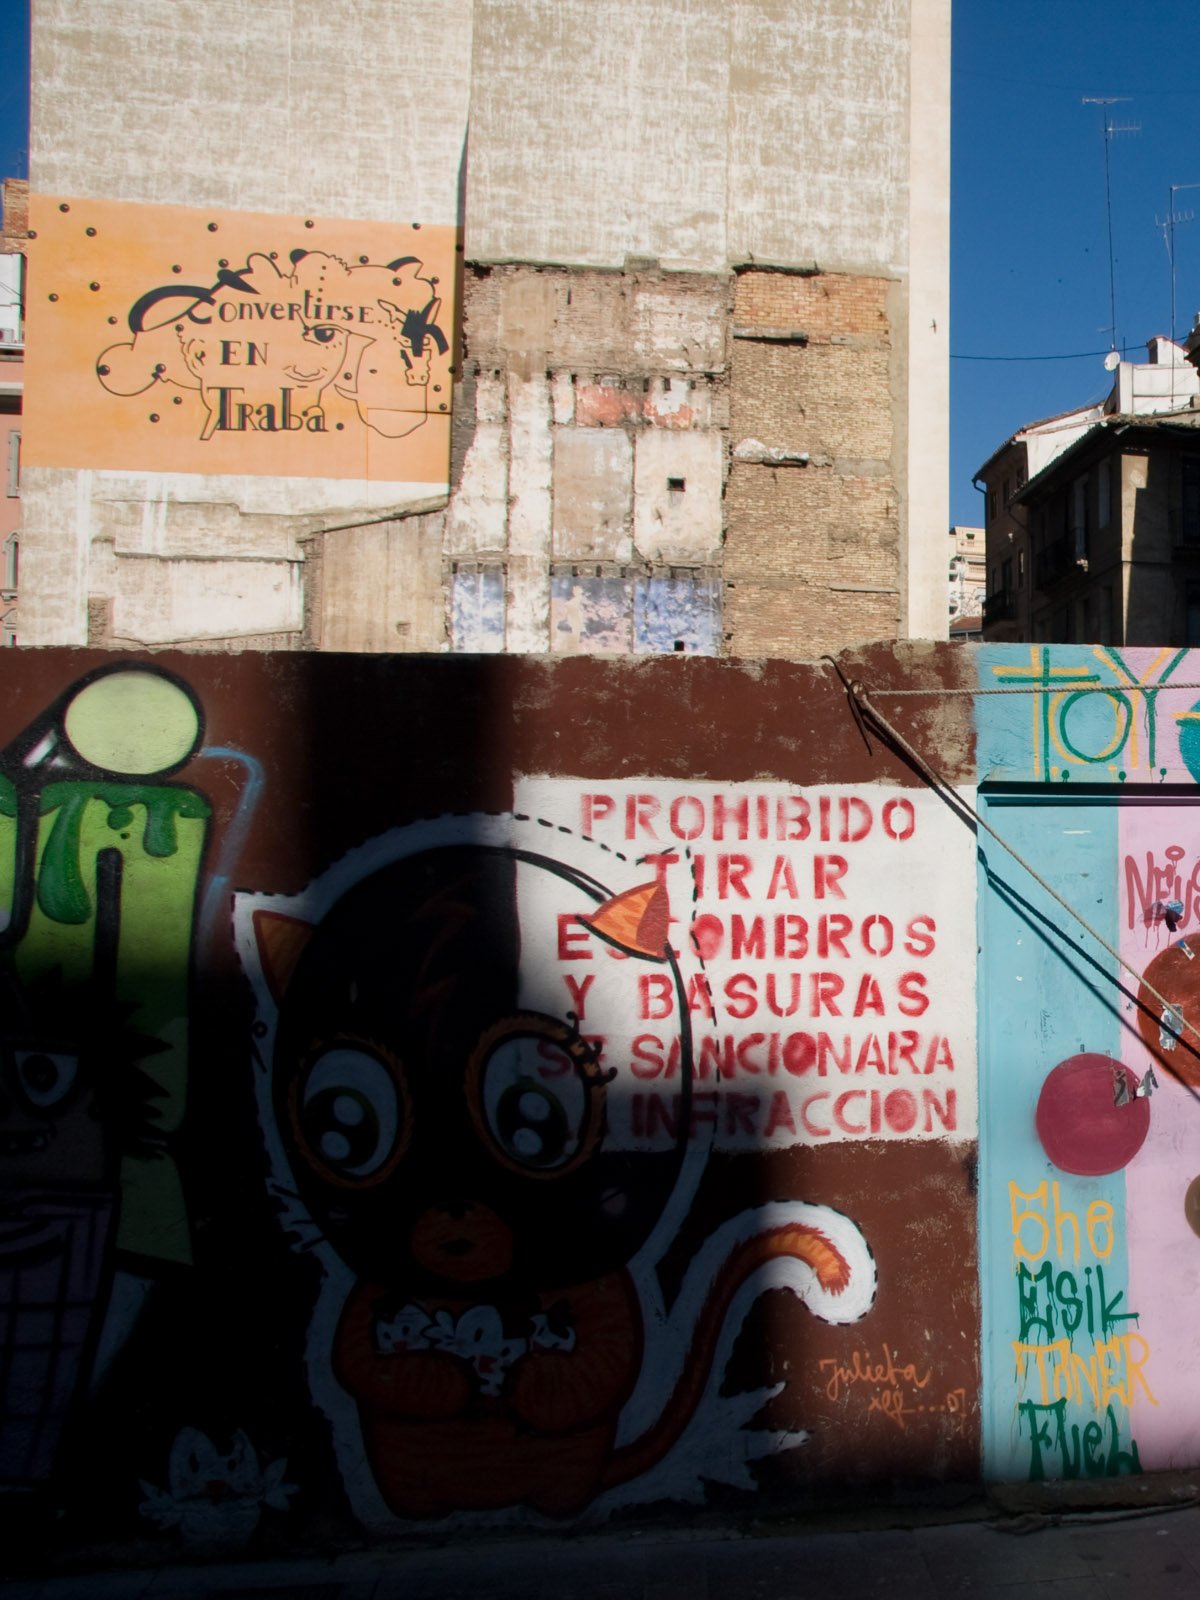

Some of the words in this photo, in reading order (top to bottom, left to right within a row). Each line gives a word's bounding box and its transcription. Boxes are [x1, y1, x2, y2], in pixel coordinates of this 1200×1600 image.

[219, 339, 269, 366] EN
[579, 793, 916, 843] PROHIBIDO
[644, 853, 849, 900] TIRAR
[557, 913, 937, 961] EOMBROS
[562, 974, 595, 1020] Y
[638, 971, 931, 1020] BASURAS
[630, 1030, 956, 1081] SANCIONARA
[632, 1088, 957, 1138] INFRACCION
[818, 1342, 933, 1401] Julieta
